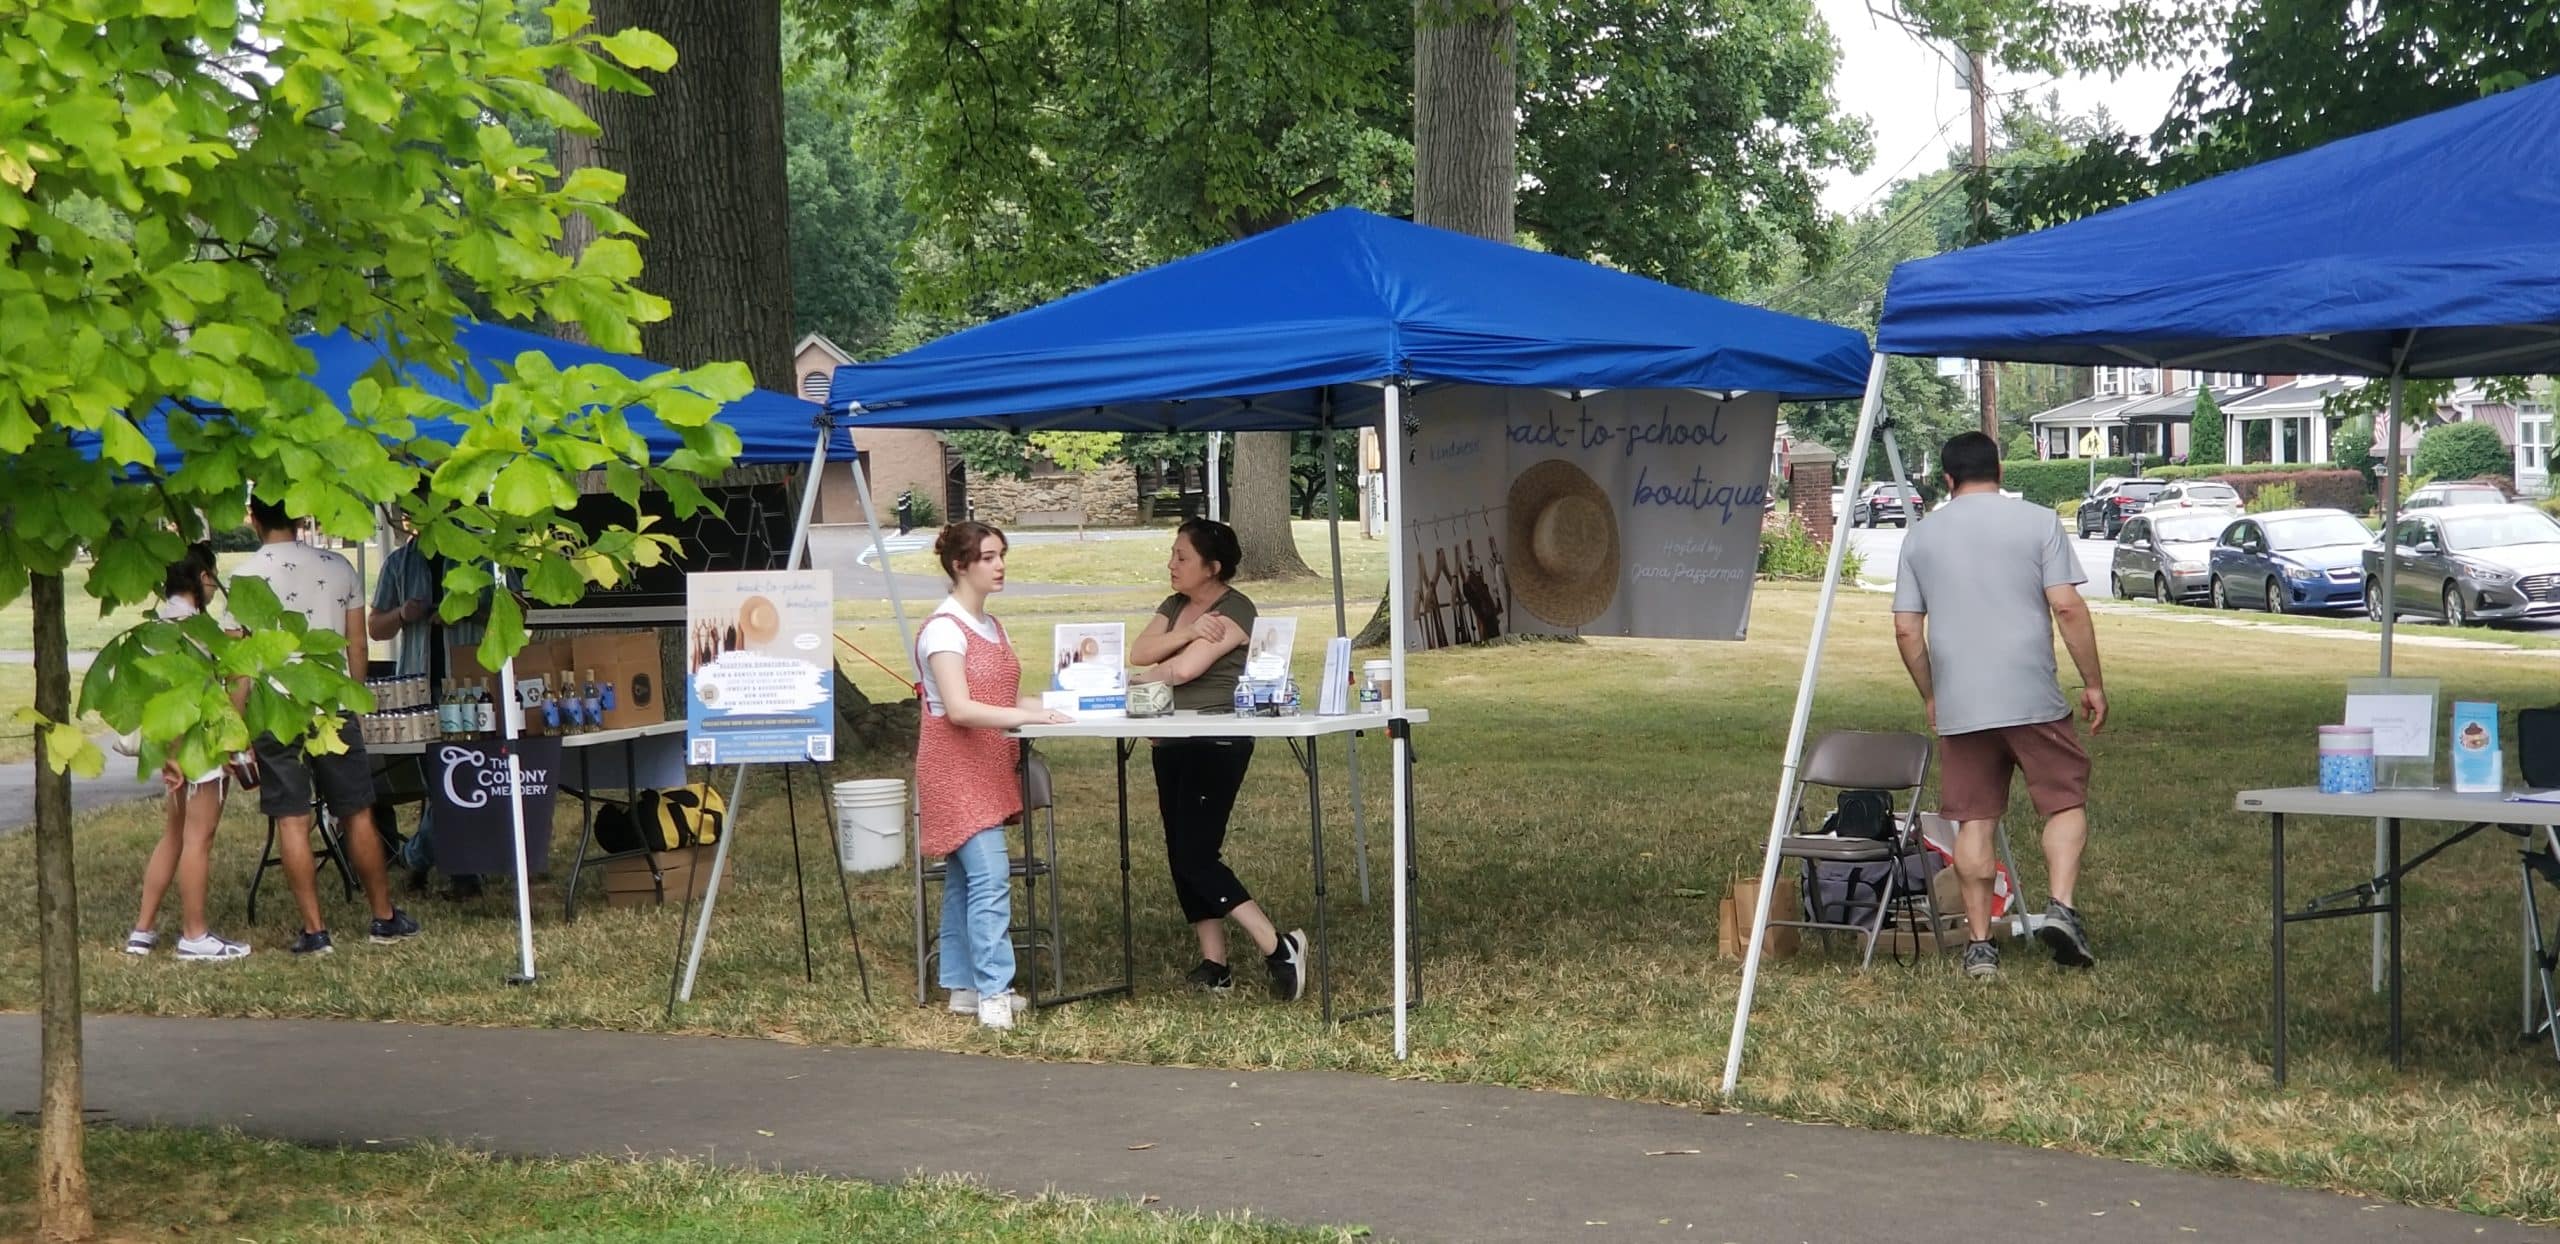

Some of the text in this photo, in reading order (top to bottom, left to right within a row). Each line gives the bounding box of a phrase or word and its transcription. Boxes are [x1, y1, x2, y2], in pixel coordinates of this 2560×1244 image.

[1507, 405, 1727, 456] ack-to-school
[1633, 466, 1767, 525] boutique
[489, 758, 511, 769] TH
[490, 785, 548, 796] MEDERY
